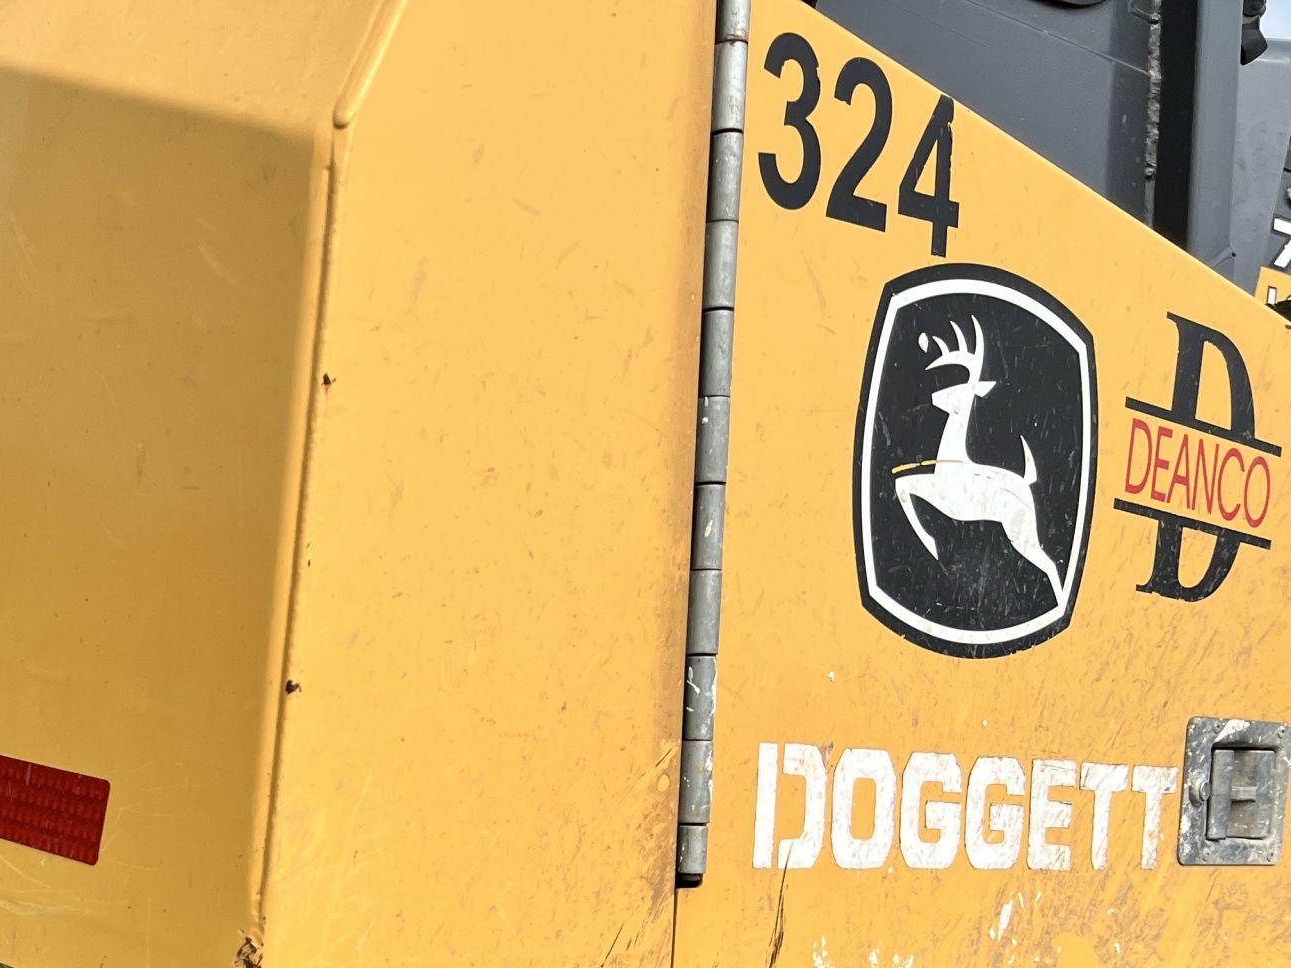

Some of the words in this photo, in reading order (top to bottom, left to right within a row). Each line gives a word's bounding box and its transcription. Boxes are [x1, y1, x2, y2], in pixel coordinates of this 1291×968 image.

[757, 32, 960, 257] 324
[1124, 418, 1272, 528] DEANCO
[752, 741, 1179, 871] DOGGETT
